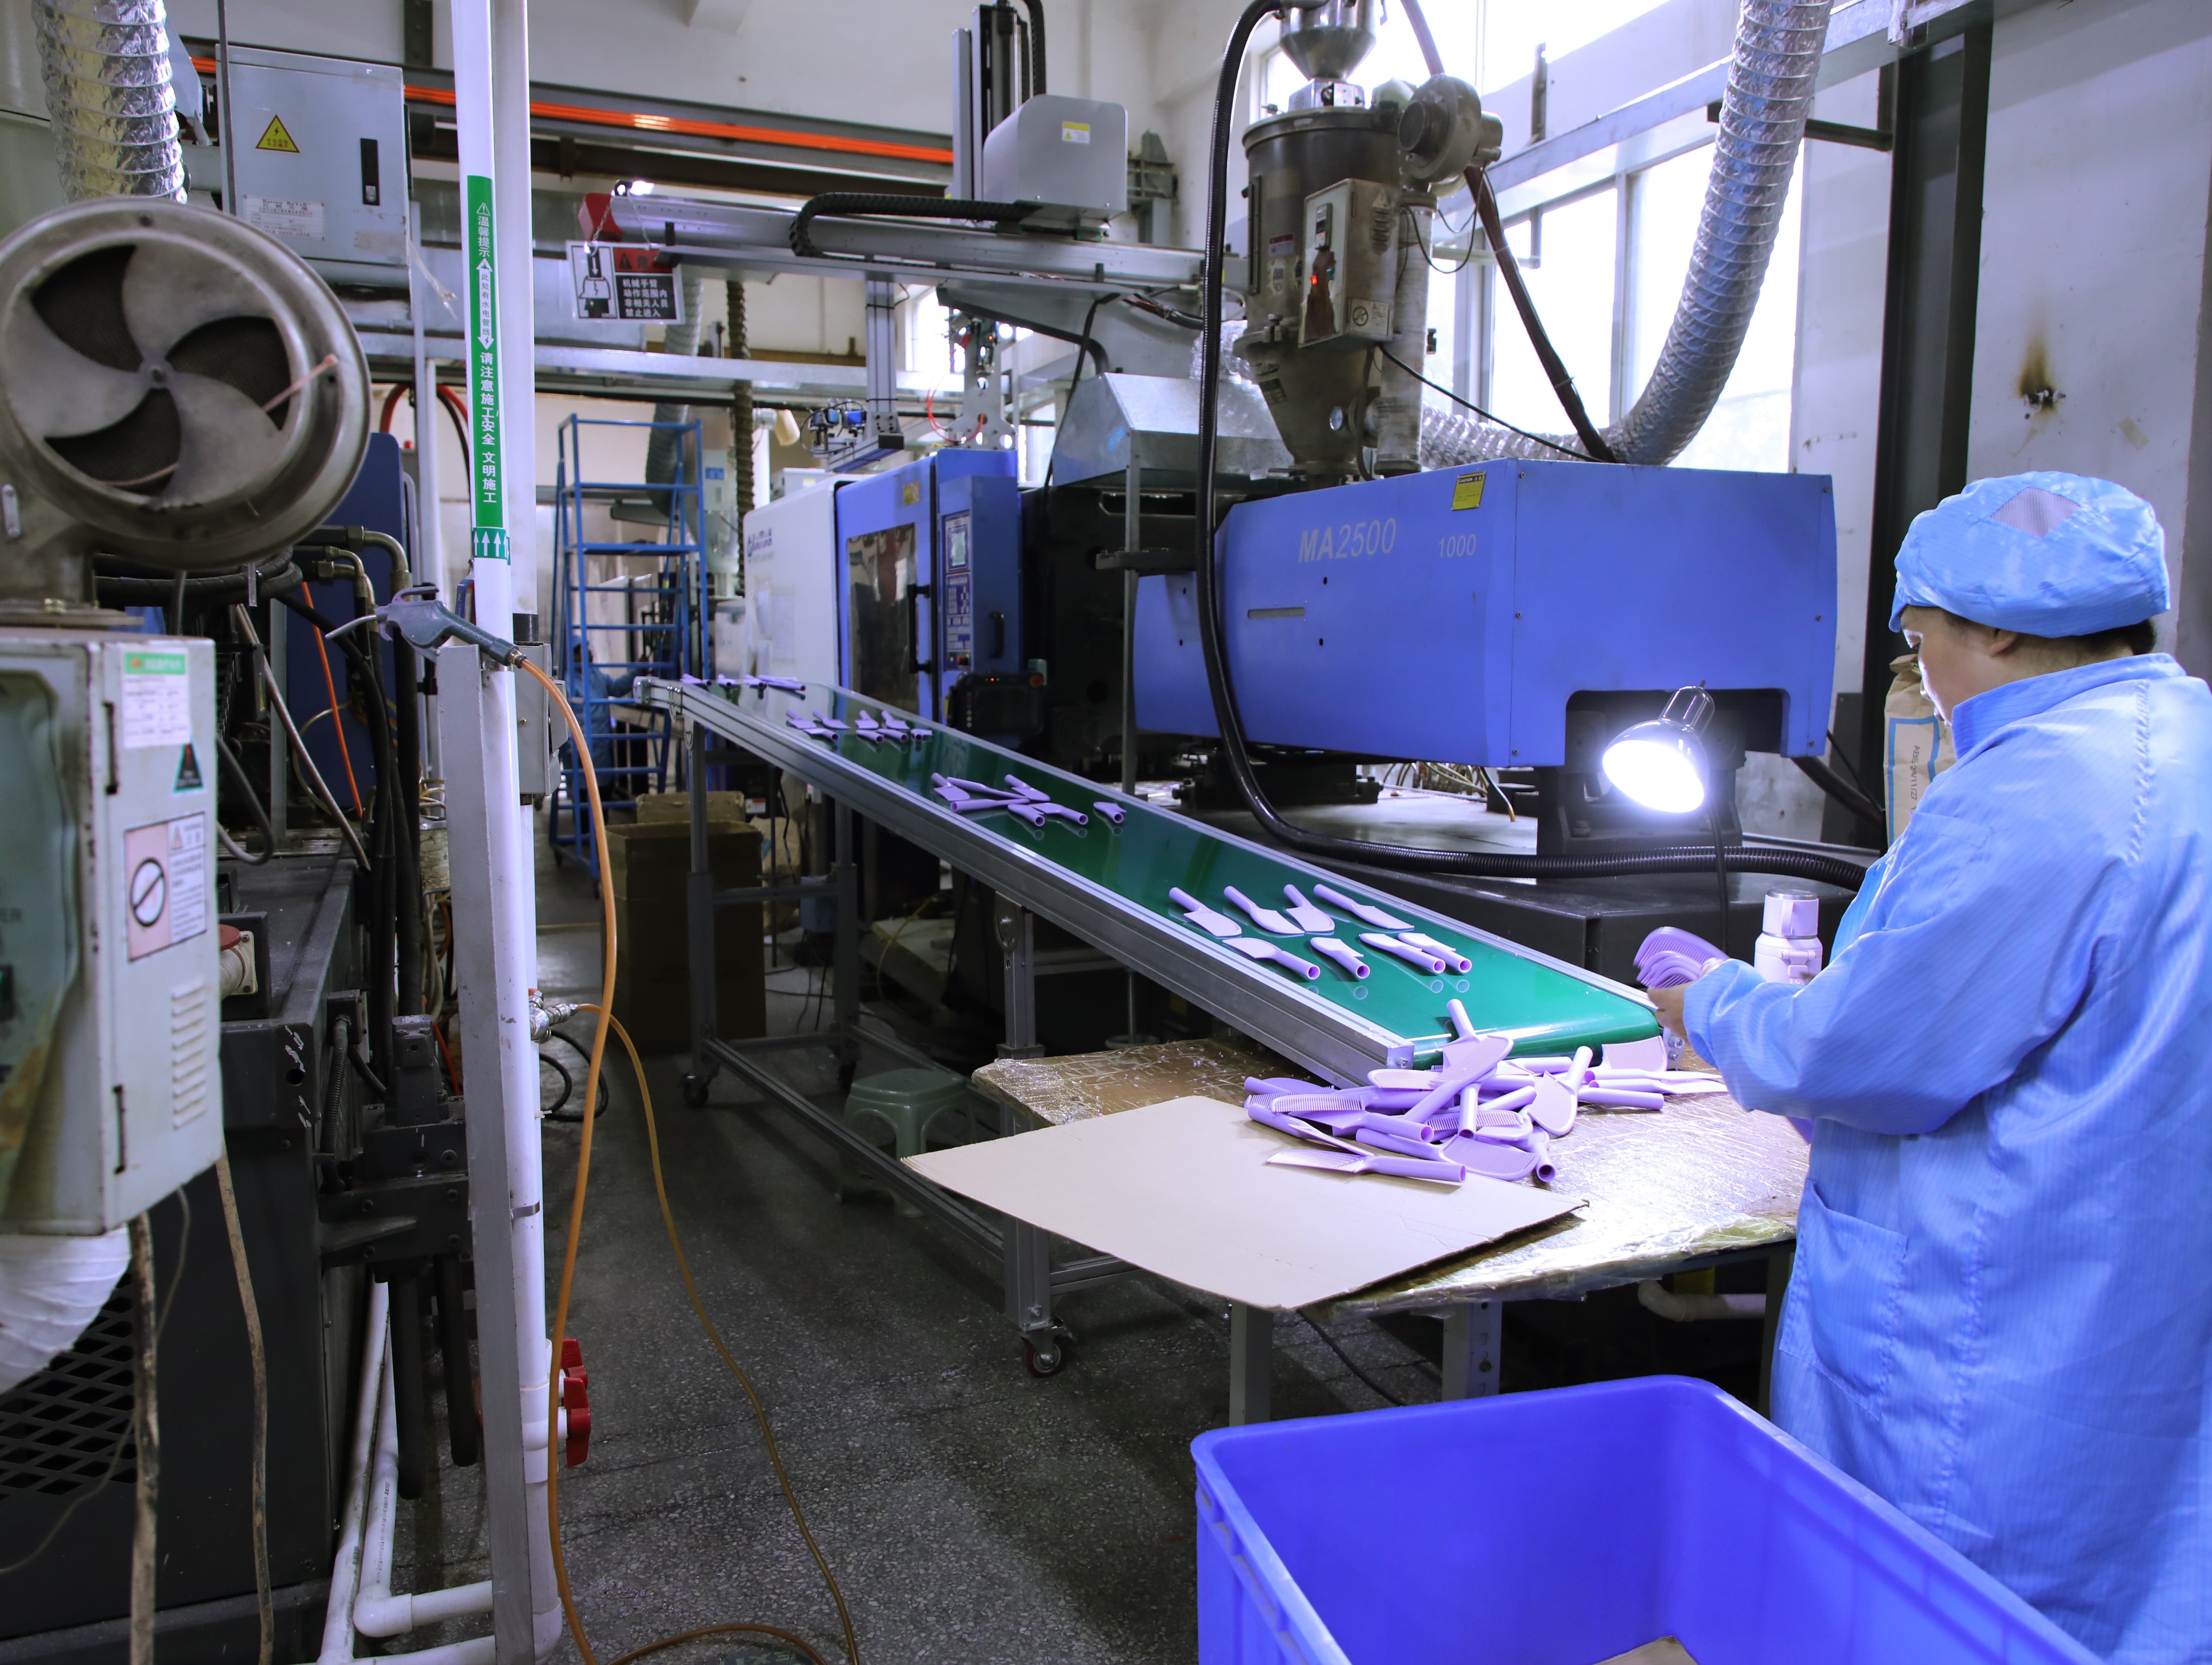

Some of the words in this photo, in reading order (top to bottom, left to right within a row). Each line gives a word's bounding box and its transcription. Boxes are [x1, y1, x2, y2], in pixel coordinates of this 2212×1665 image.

[478, 215, 490, 257] 温馨提示
[622, 278, 657, 289] 机械手臂
[623, 289, 667, 298] 动作范围内
[481, 273, 490, 336] 此处有水电管线
[624, 298, 668, 308] 非相关人员
[625, 308, 661, 318] 禁止进入
[479, 352, 495, 446] 请注意施工安全
[482, 451, 497, 503] 文明施工
[1298, 517, 1397, 563] MA2500
[1439, 534, 1477, 557] 1000
[1911, 745, 1920, 764] ABS
